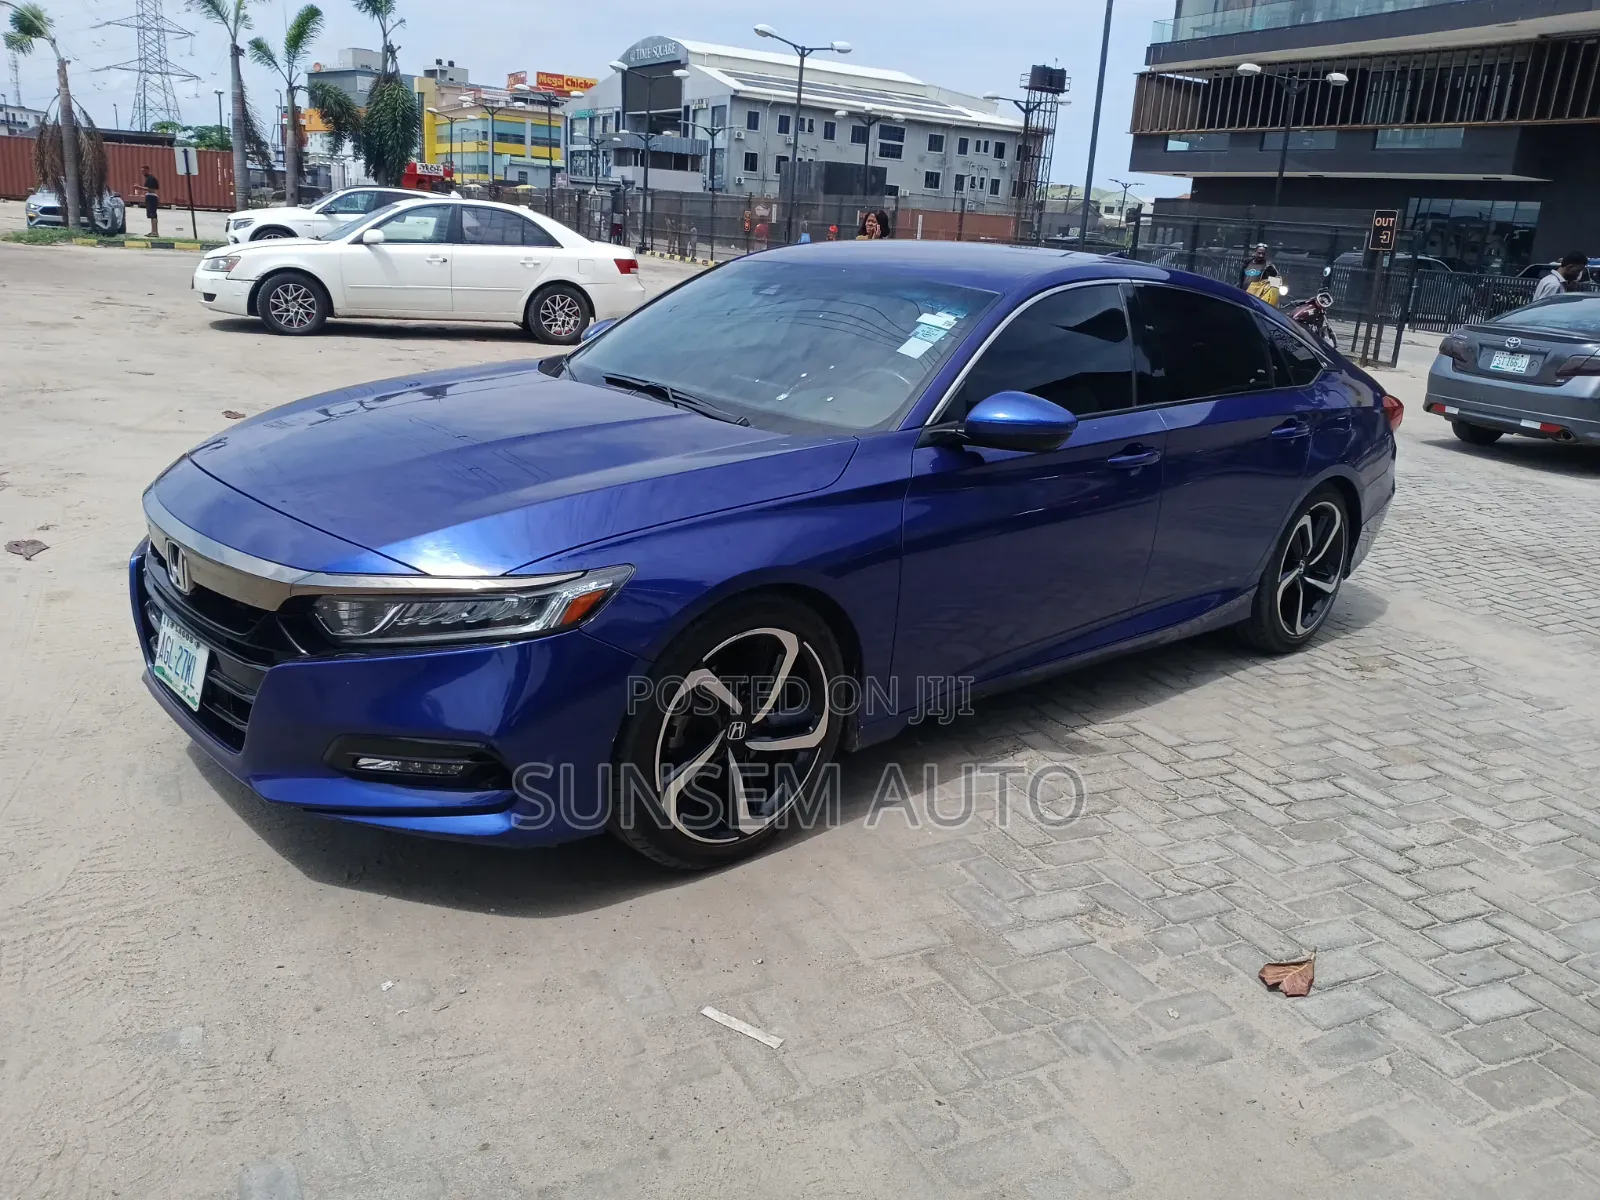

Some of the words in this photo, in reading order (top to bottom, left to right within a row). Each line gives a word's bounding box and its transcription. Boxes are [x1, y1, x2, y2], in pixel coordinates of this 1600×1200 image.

[652, 42, 676, 59] SQUARE
[538, 73, 563, 87] Mega
[565, 77, 596, 90] Chicke
[1375, 217, 1395, 227] OUT
